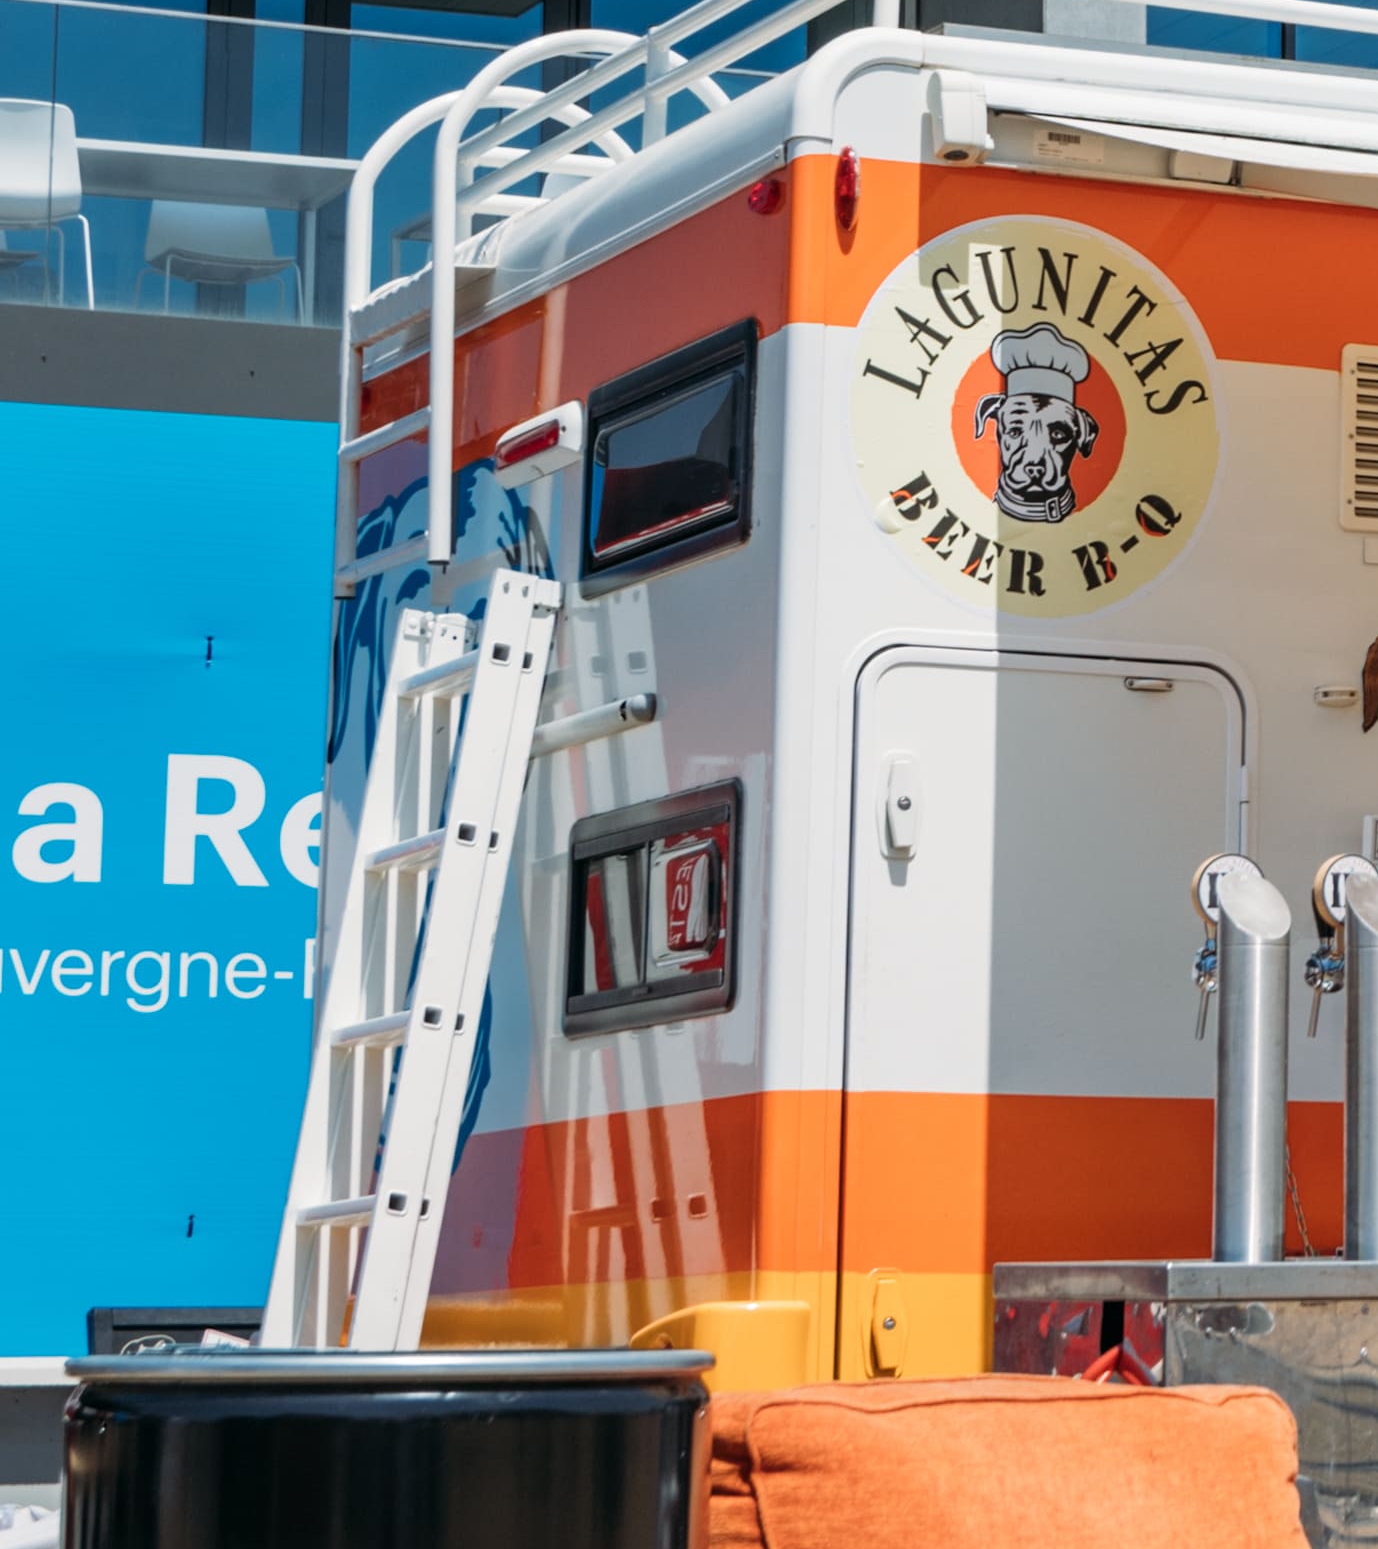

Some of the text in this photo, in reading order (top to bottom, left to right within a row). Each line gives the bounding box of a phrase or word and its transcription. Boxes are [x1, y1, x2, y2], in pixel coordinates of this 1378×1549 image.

[863, 247, 1208, 414] LAGUNITAS
[889, 470, 1182, 596] BEER B-Q
